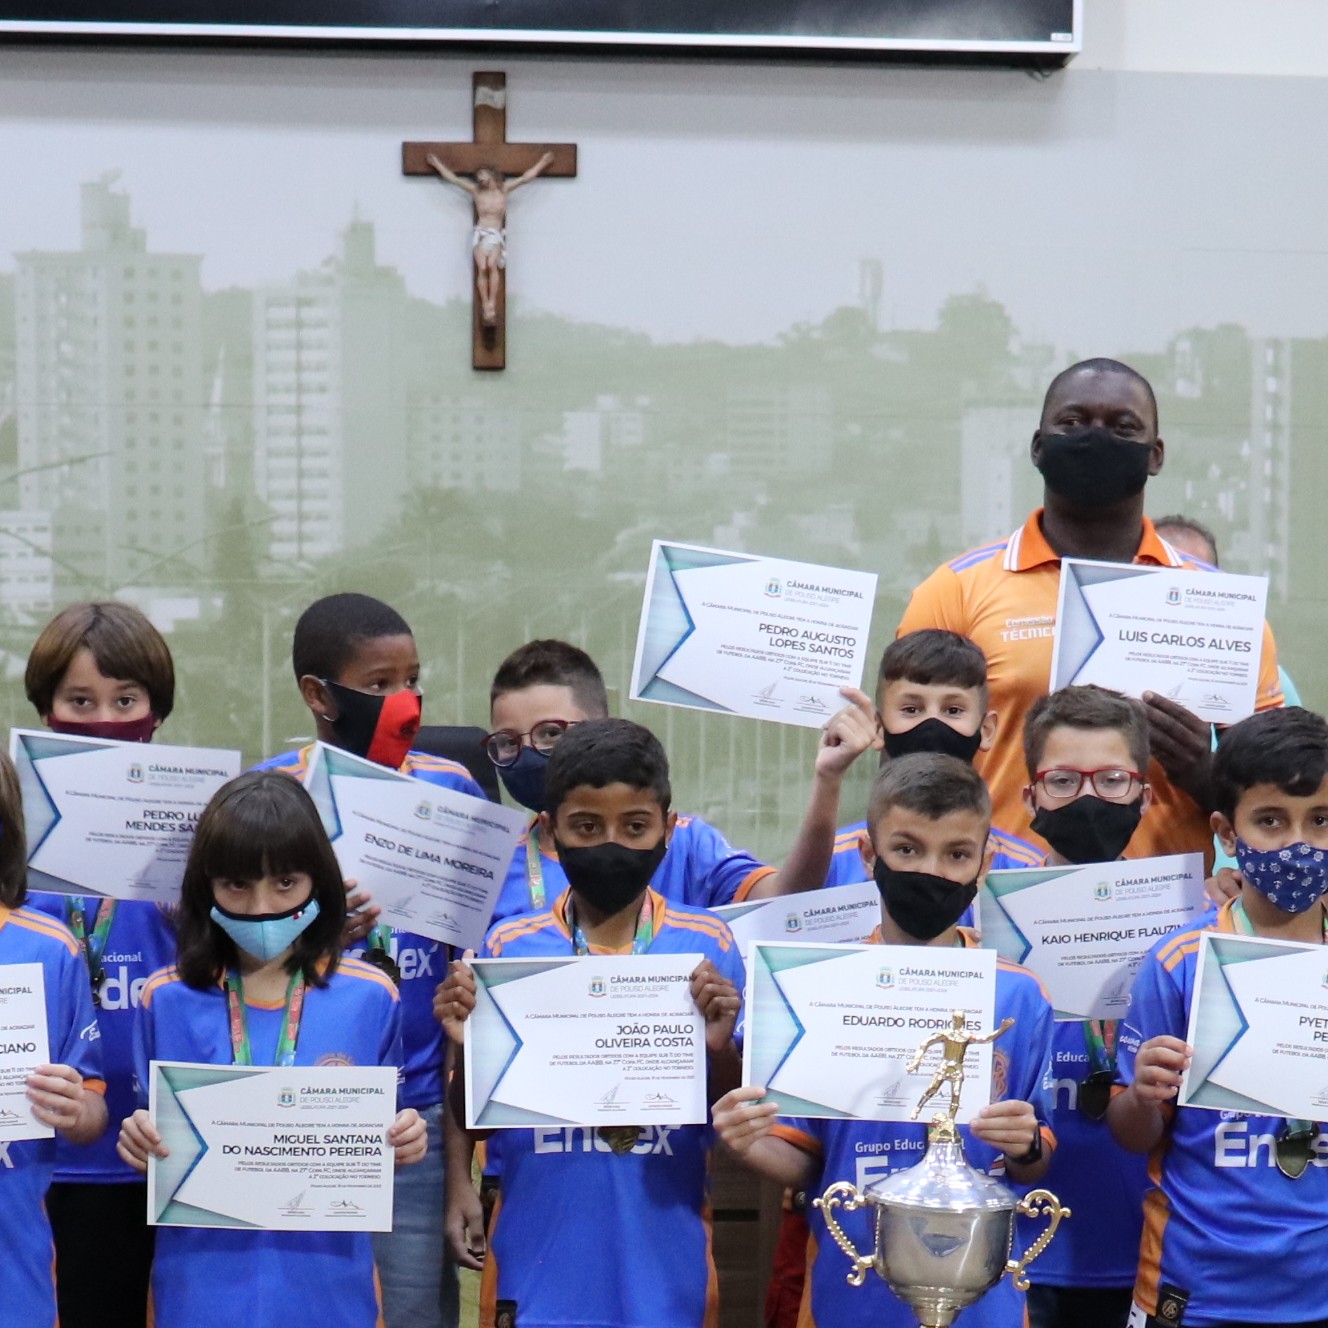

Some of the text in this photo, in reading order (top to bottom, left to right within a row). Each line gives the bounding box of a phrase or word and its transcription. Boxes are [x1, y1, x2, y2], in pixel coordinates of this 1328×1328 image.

[787, 580, 863, 599] CÂMARA MUNICIPAL
[1186, 588, 1256, 601] CÂMARA MUNICIPAL
[759, 623, 856, 646] PEDRO AUGUSTO
[1119, 629, 1251, 653] LUIS CARLOS ALVES
[769, 637, 854, 659] LOPES SANTOS
[143, 810, 200, 821] PEDRO LU
[126, 821, 197, 832] MENDES SA
[364, 833, 494, 880] ENZO DE LIMA MOREIRA
[1115, 873, 1193, 887] CÂMARA MUNICIPAL
[804, 900, 878, 918] CÂMARA MUNICIPAL
[1042, 934, 1070, 945] KAIO
[1074, 929, 1135, 943] HENRIQUE
[610, 975, 646, 983] CÂMARA
[899, 967, 984, 979] CÂMARA MUNICIPAL
[843, 1015, 905, 1027] EDUARDO
[617, 1023, 694, 1035] JOÃO PAULO
[595, 1038, 694, 1048] OLIVEIRA COSTA
[300, 1086, 337, 1095] CÂMARA
[274, 1134, 382, 1144] MIGUEL SANTANA
[223, 1145, 382, 1156] DO NASCIMENTO PEREIRA
[855, 1141, 891, 1154] Grupo
